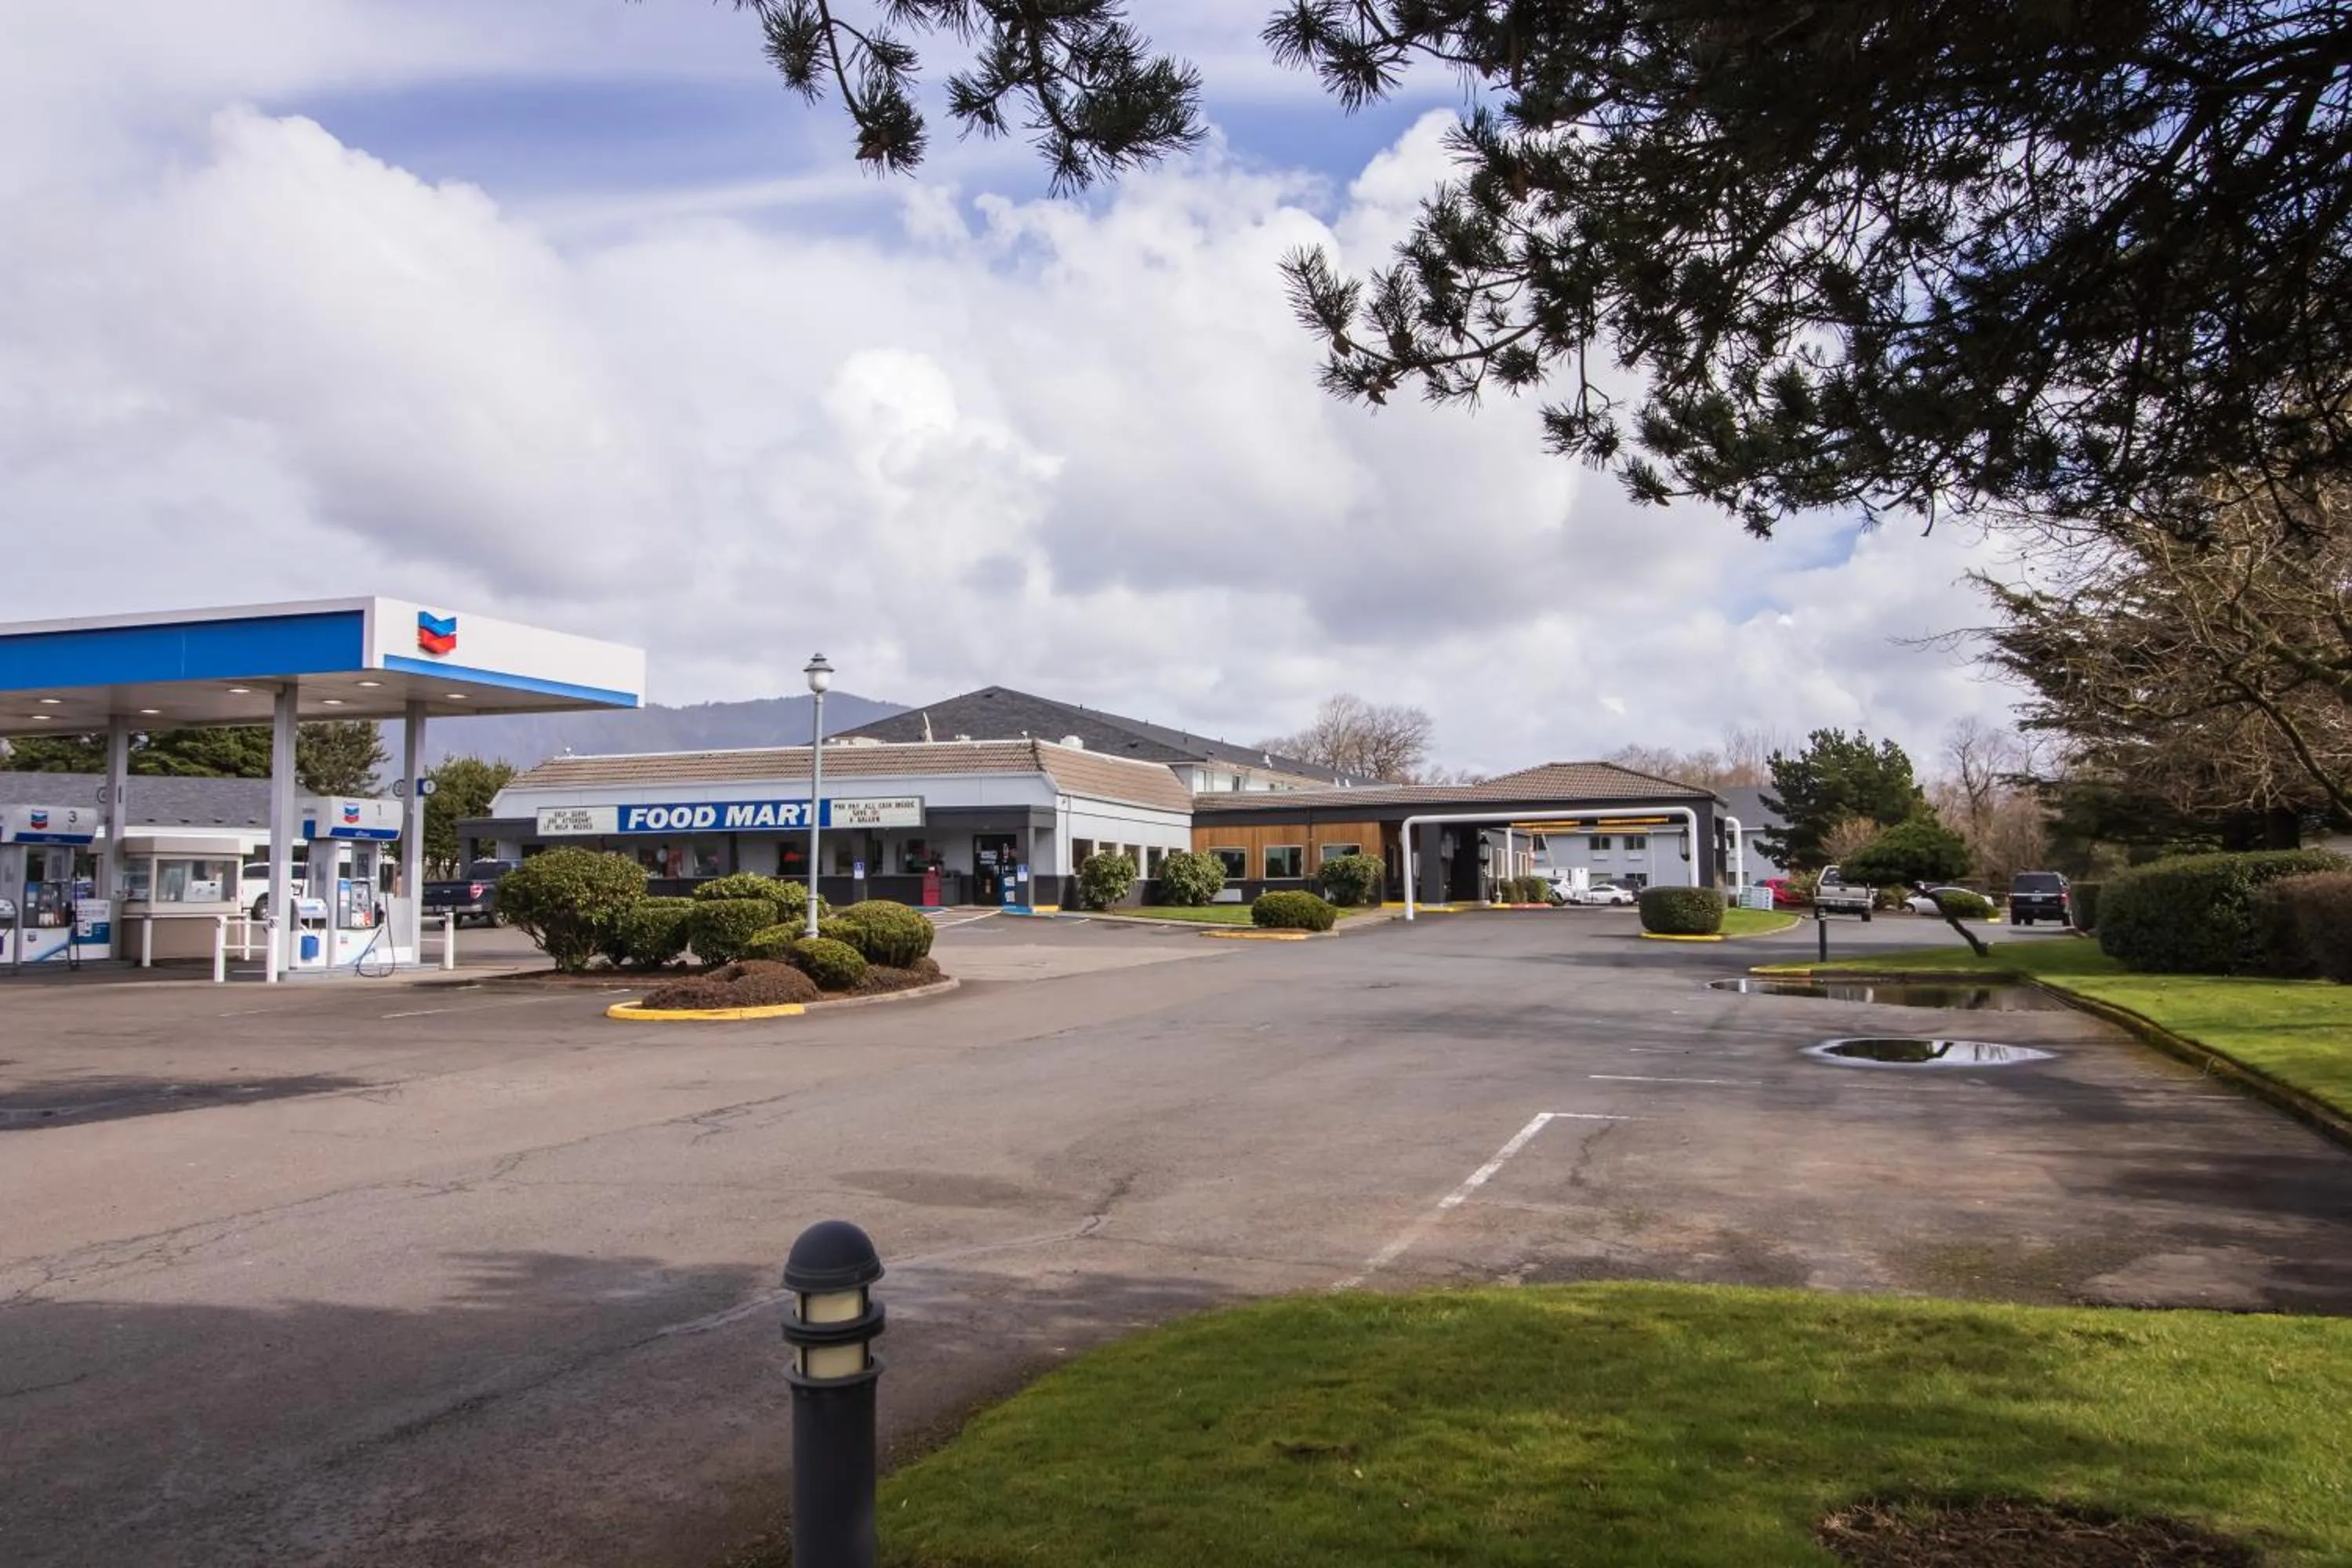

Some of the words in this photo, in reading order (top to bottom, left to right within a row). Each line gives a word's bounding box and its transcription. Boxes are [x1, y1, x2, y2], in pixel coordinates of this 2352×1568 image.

[68, 810, 78, 823] 3
[376, 804, 382, 816] 1
[628, 806, 717, 829] FOOD
[724, 802, 813, 827] MART
